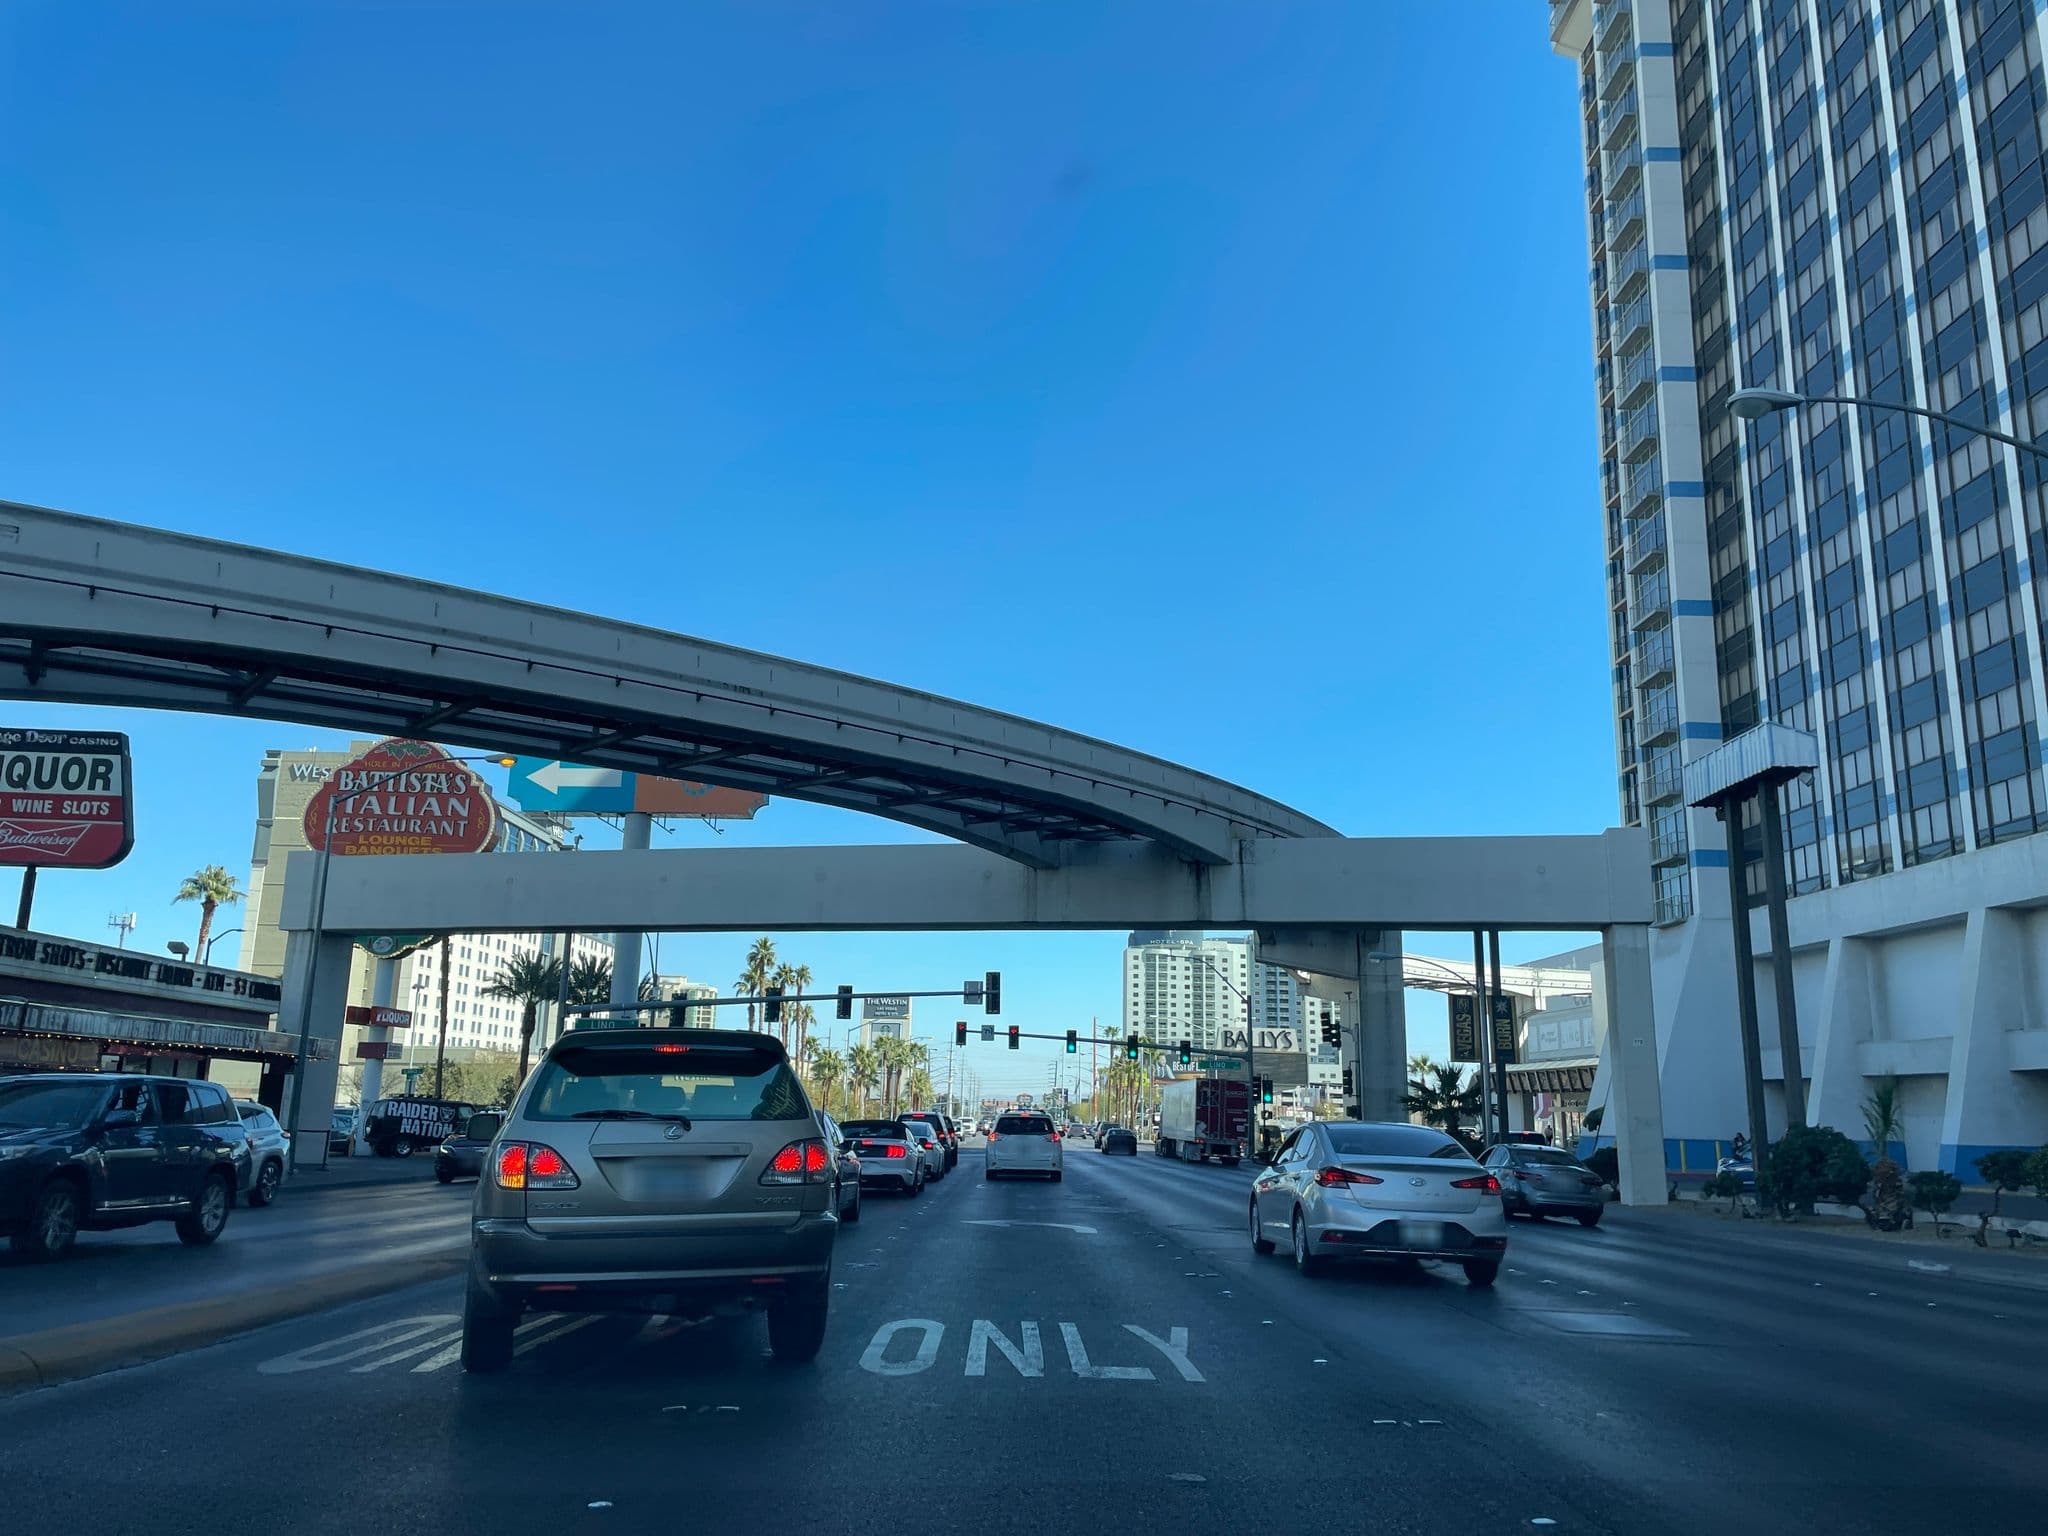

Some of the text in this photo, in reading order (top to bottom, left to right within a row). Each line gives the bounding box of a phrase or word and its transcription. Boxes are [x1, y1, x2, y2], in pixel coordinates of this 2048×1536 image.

[69, 736, 119, 746] CASINO
[339, 770, 466, 794] BATTISTA'S
[12, 798, 110, 815] WINE SLOTS
[328, 795, 471, 817] ITALIAN
[0, 828, 78, 845] Budweiser
[325, 817, 469, 838] RESTAURANT
[358, 834, 433, 846] LOUNGE
[1496, 1018, 1513, 1050] BORN
[17, 1039, 80, 1063] CASINO
[387, 1101, 439, 1121] RAIDER
[400, 1118, 453, 1138] NATION
[858, 1318, 1207, 1382] ONLY
